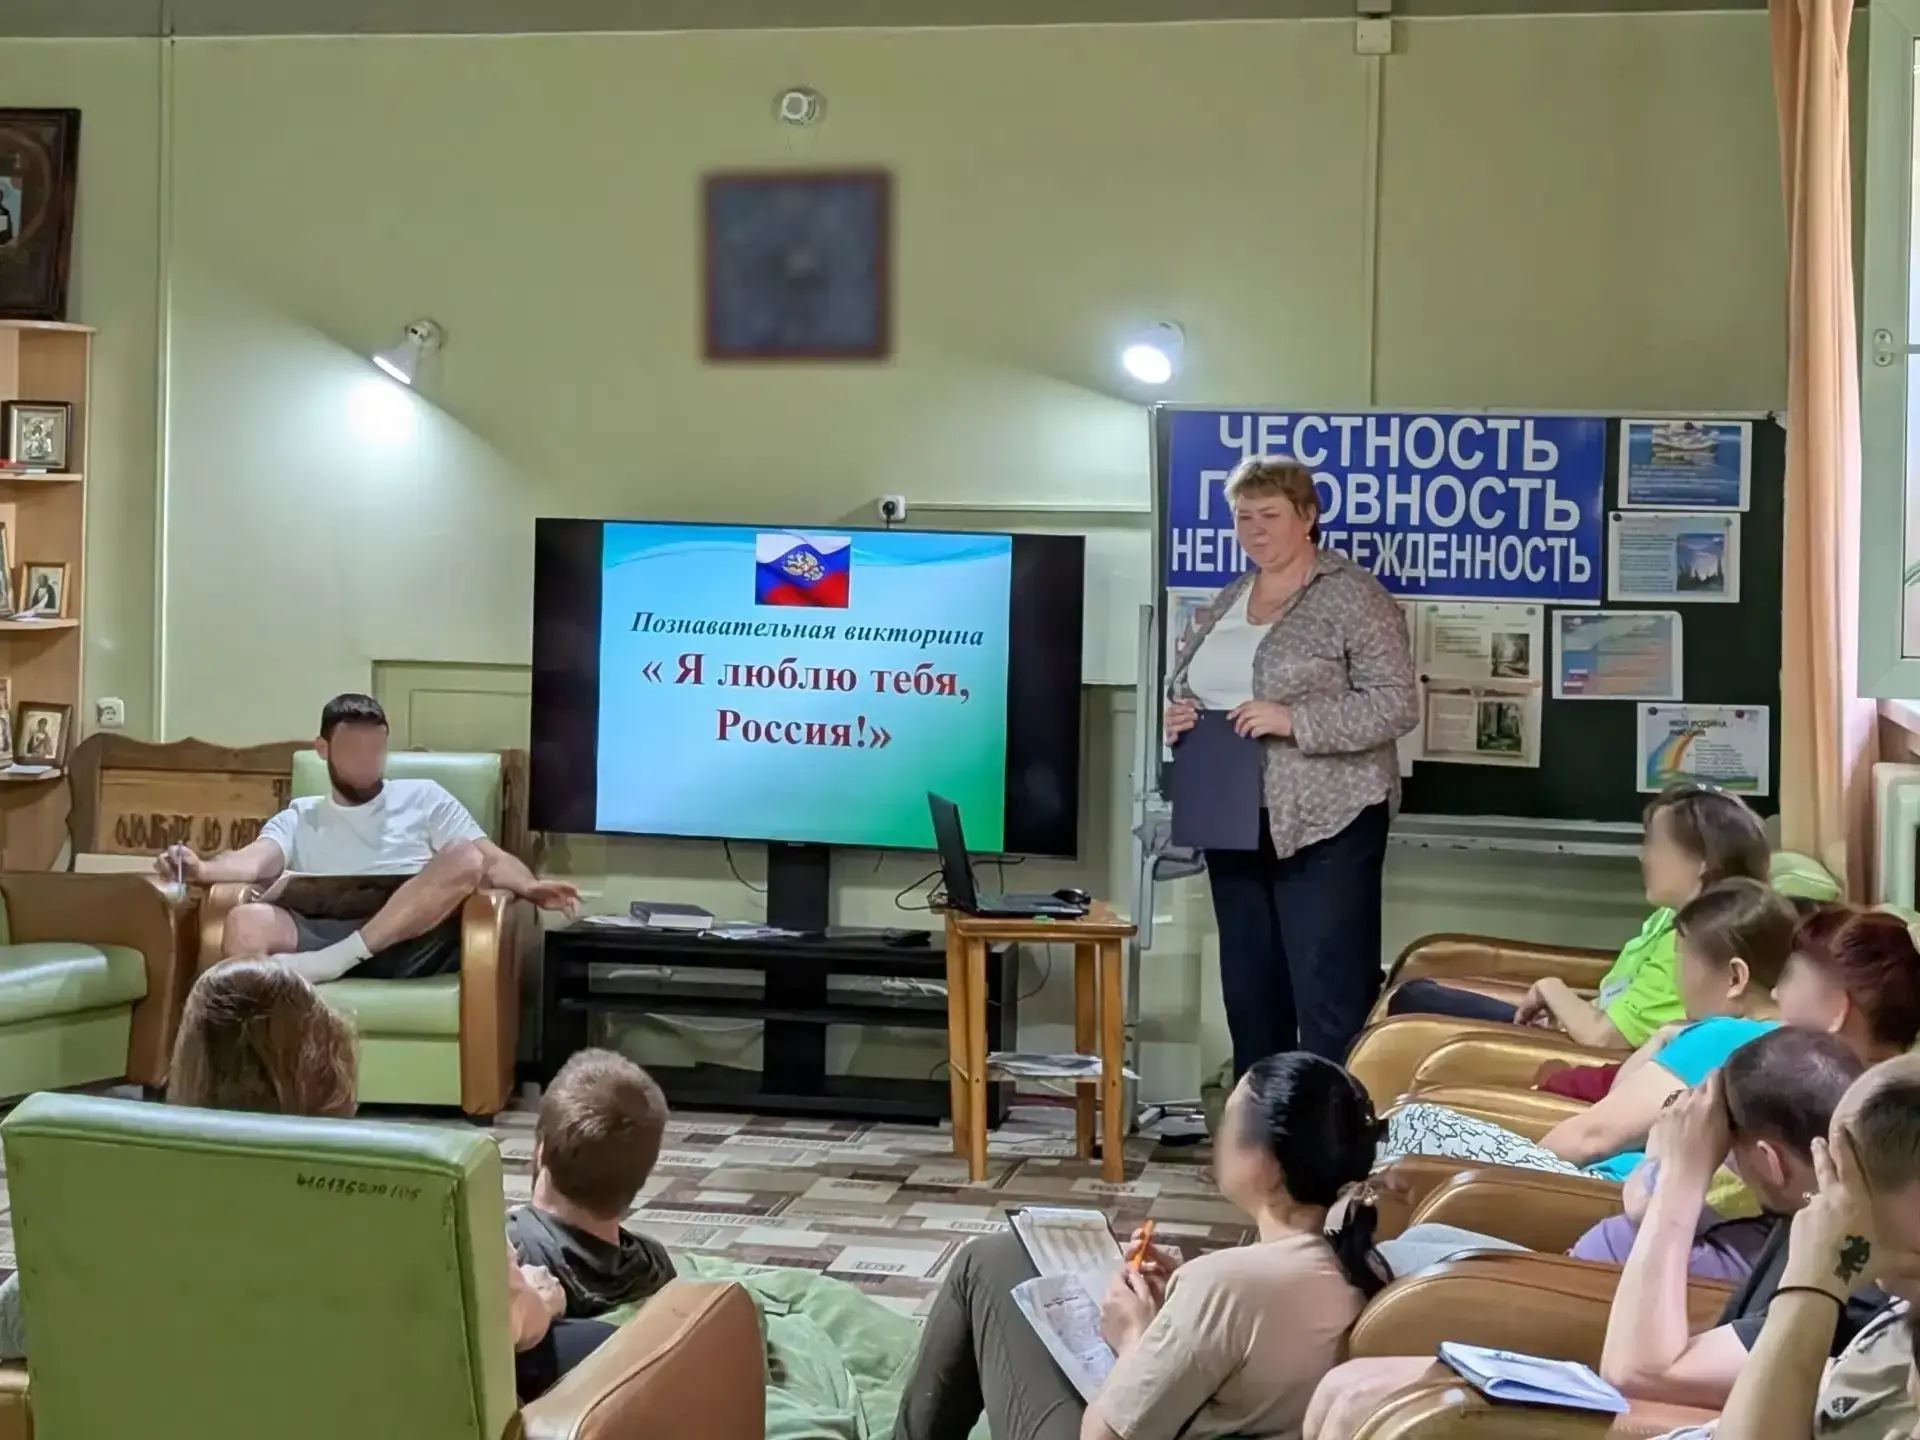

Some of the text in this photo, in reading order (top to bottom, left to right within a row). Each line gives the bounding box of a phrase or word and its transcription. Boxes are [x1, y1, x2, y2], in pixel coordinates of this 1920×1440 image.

[1220, 415, 1559, 471] ЧЕСТНОСТЬ
[1199, 470, 1580, 531] ГОВНОСТЬ
[1172, 528, 1591, 587] НЕПБЕЖДЕННОСТЬ
[630, 611, 984, 649] Познавательная викторина
[673, 653, 706, 685] Я
[717, 657, 857, 692] люблю
[869, 662, 970, 704] тебя,
[716, 709, 892, 749] Россия!»
